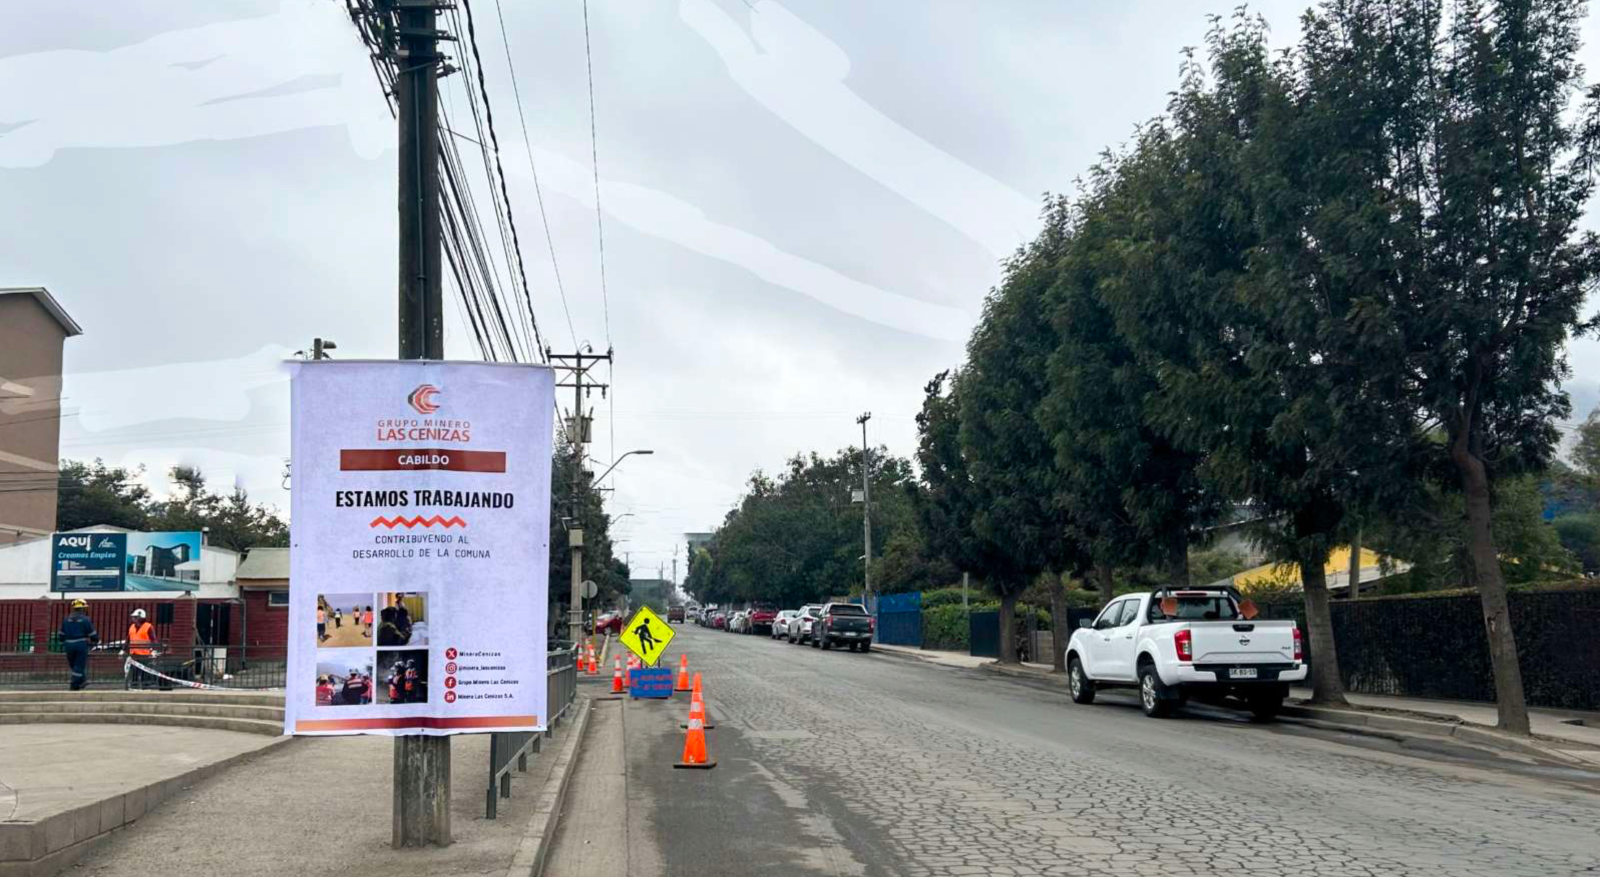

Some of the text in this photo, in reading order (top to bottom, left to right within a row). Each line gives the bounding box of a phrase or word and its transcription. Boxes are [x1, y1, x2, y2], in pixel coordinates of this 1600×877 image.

[377, 419, 471, 429] GRUPO MINERO
[377, 428, 471, 442] LAS CENIZAS
[397, 454, 450, 466] CABILDO
[335, 489, 514, 509] ESTAMOS TRABAJANDO
[375, 534, 469, 544] CONTRIBUYENDO AL
[90, 552, 116, 560] Empleo
[352, 548, 491, 559] DESARROLLO DE LA COMUNA
